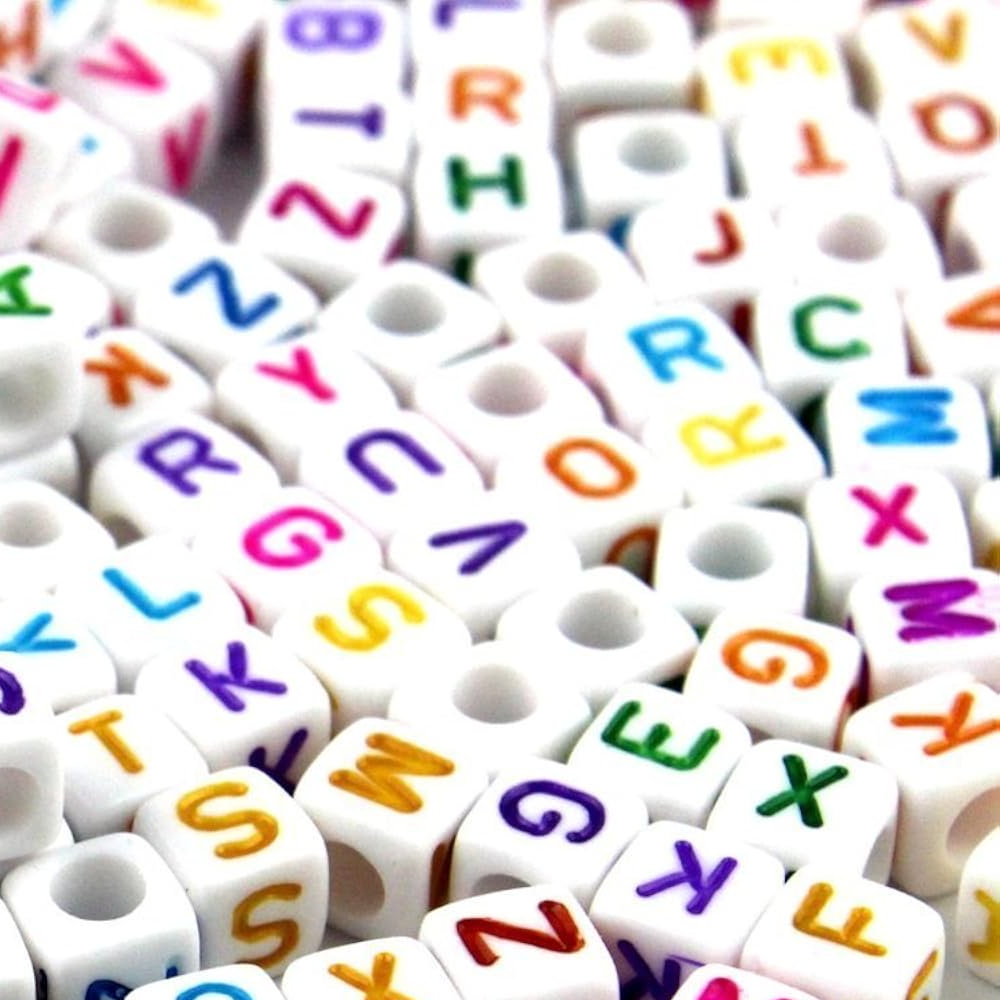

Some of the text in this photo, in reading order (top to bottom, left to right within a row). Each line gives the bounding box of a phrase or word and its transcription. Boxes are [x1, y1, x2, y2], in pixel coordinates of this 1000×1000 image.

[447, 66, 525, 123] R
[447, 154, 526, 208] H
[625, 314, 725, 385] R
[790, 293, 872, 360] C
[255, 345, 338, 405] Y
[136, 428, 240, 498] R
[677, 402, 788, 470] R
[239, 503, 346, 572] G
[848, 482, 929, 550] X
[100, 565, 203, 624] L
[310, 581, 429, 656] S
[184, 640, 288, 714] K
[719, 626, 833, 692] G
[66, 707, 147, 777] T
[600, 699, 722, 772] E
[173, 778, 283, 862] S
[497, 779, 606, 843] G
[755, 753, 850, 830] X
[635, 839, 739, 917] K
[230, 881, 305, 971] S
[790, 879, 891, 960] F
